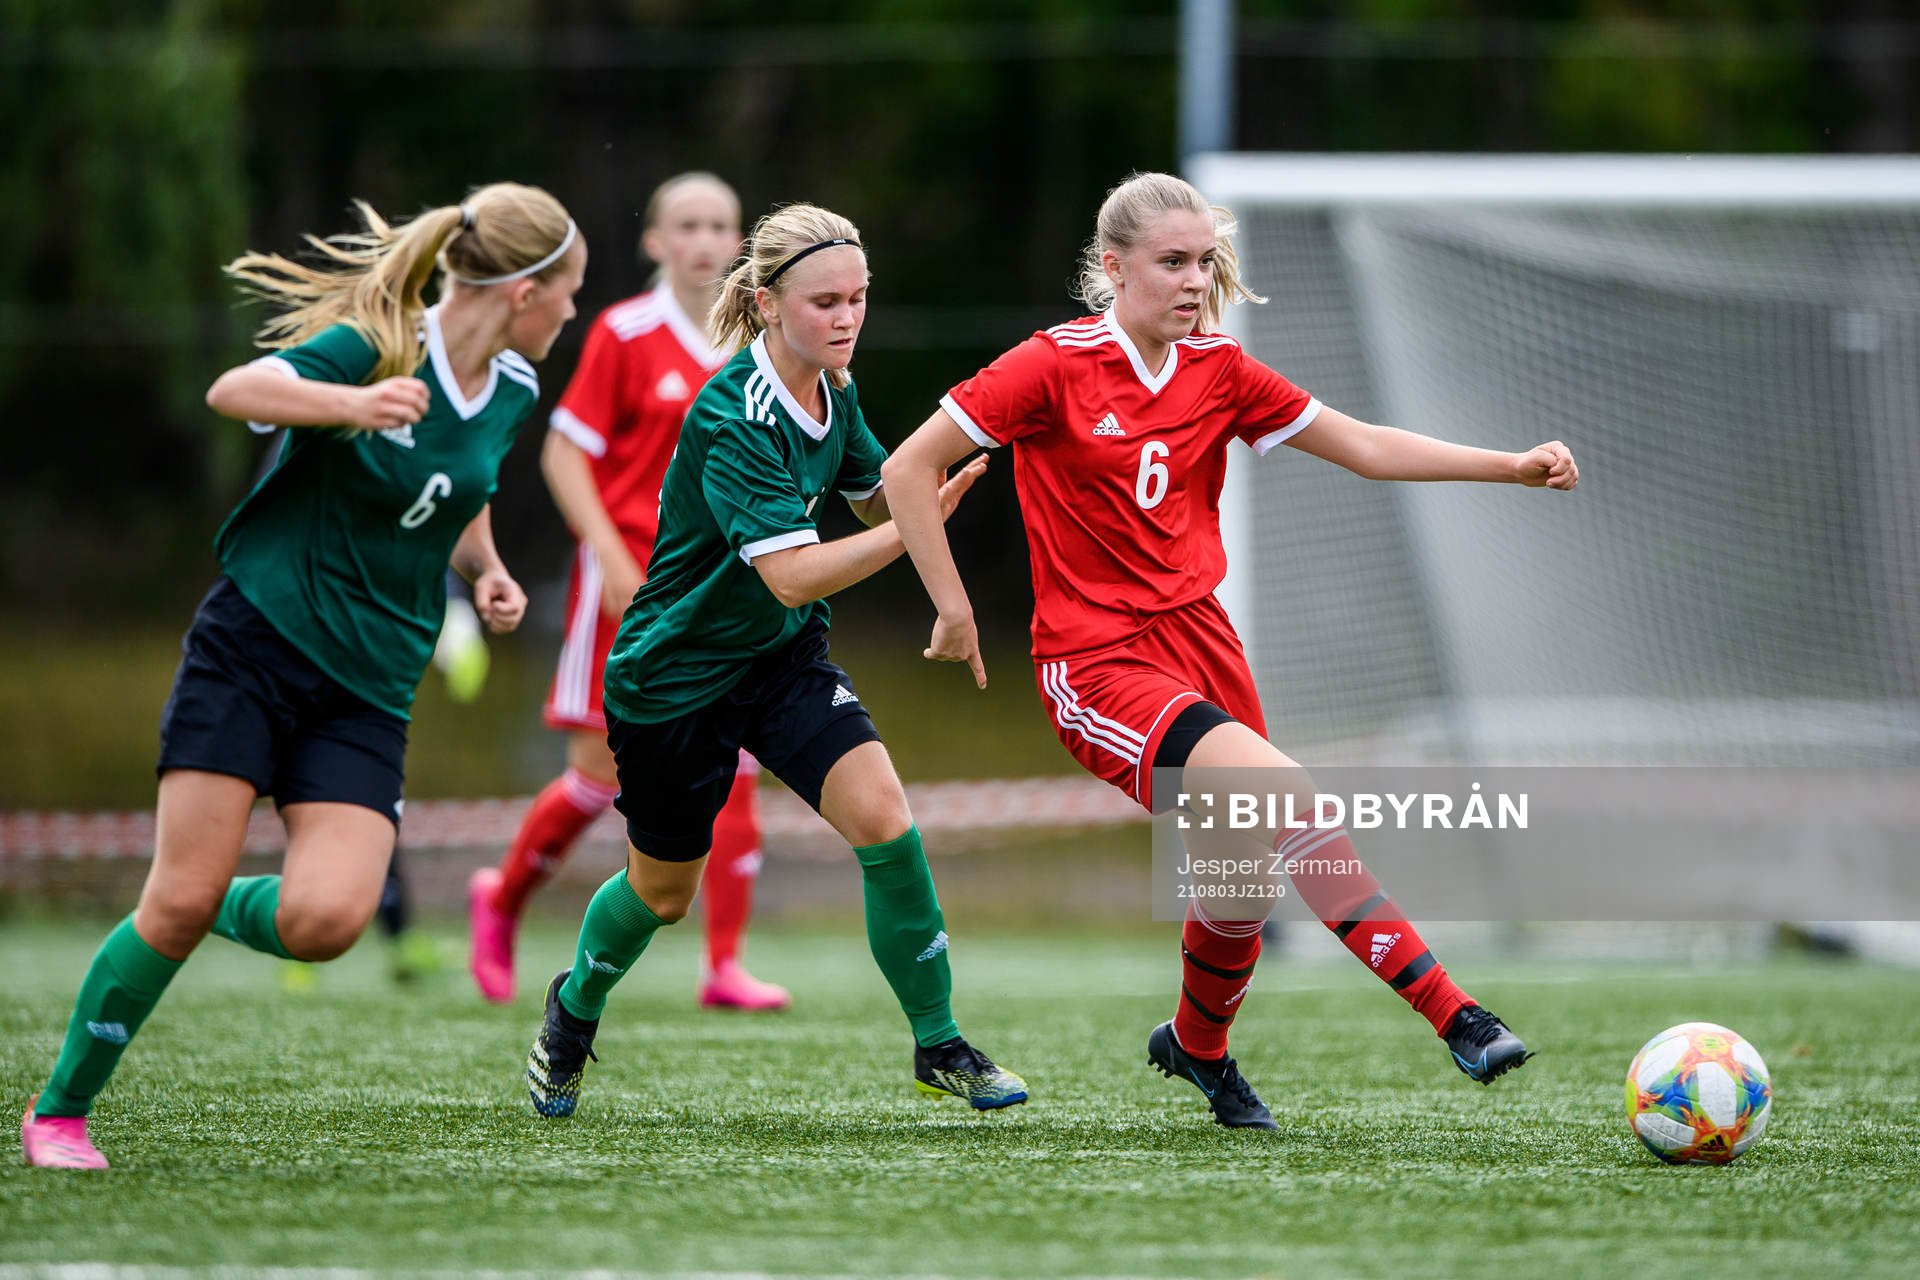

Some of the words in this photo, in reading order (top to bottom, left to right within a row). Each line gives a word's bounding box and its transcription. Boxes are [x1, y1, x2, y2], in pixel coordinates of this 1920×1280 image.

[1092, 426, 1126, 436] adidas
[1135, 440, 1169, 510] 6
[399, 472, 452, 529] 6
[831, 695, 859, 707] adidas
[1372, 932, 1402, 968] adidas
